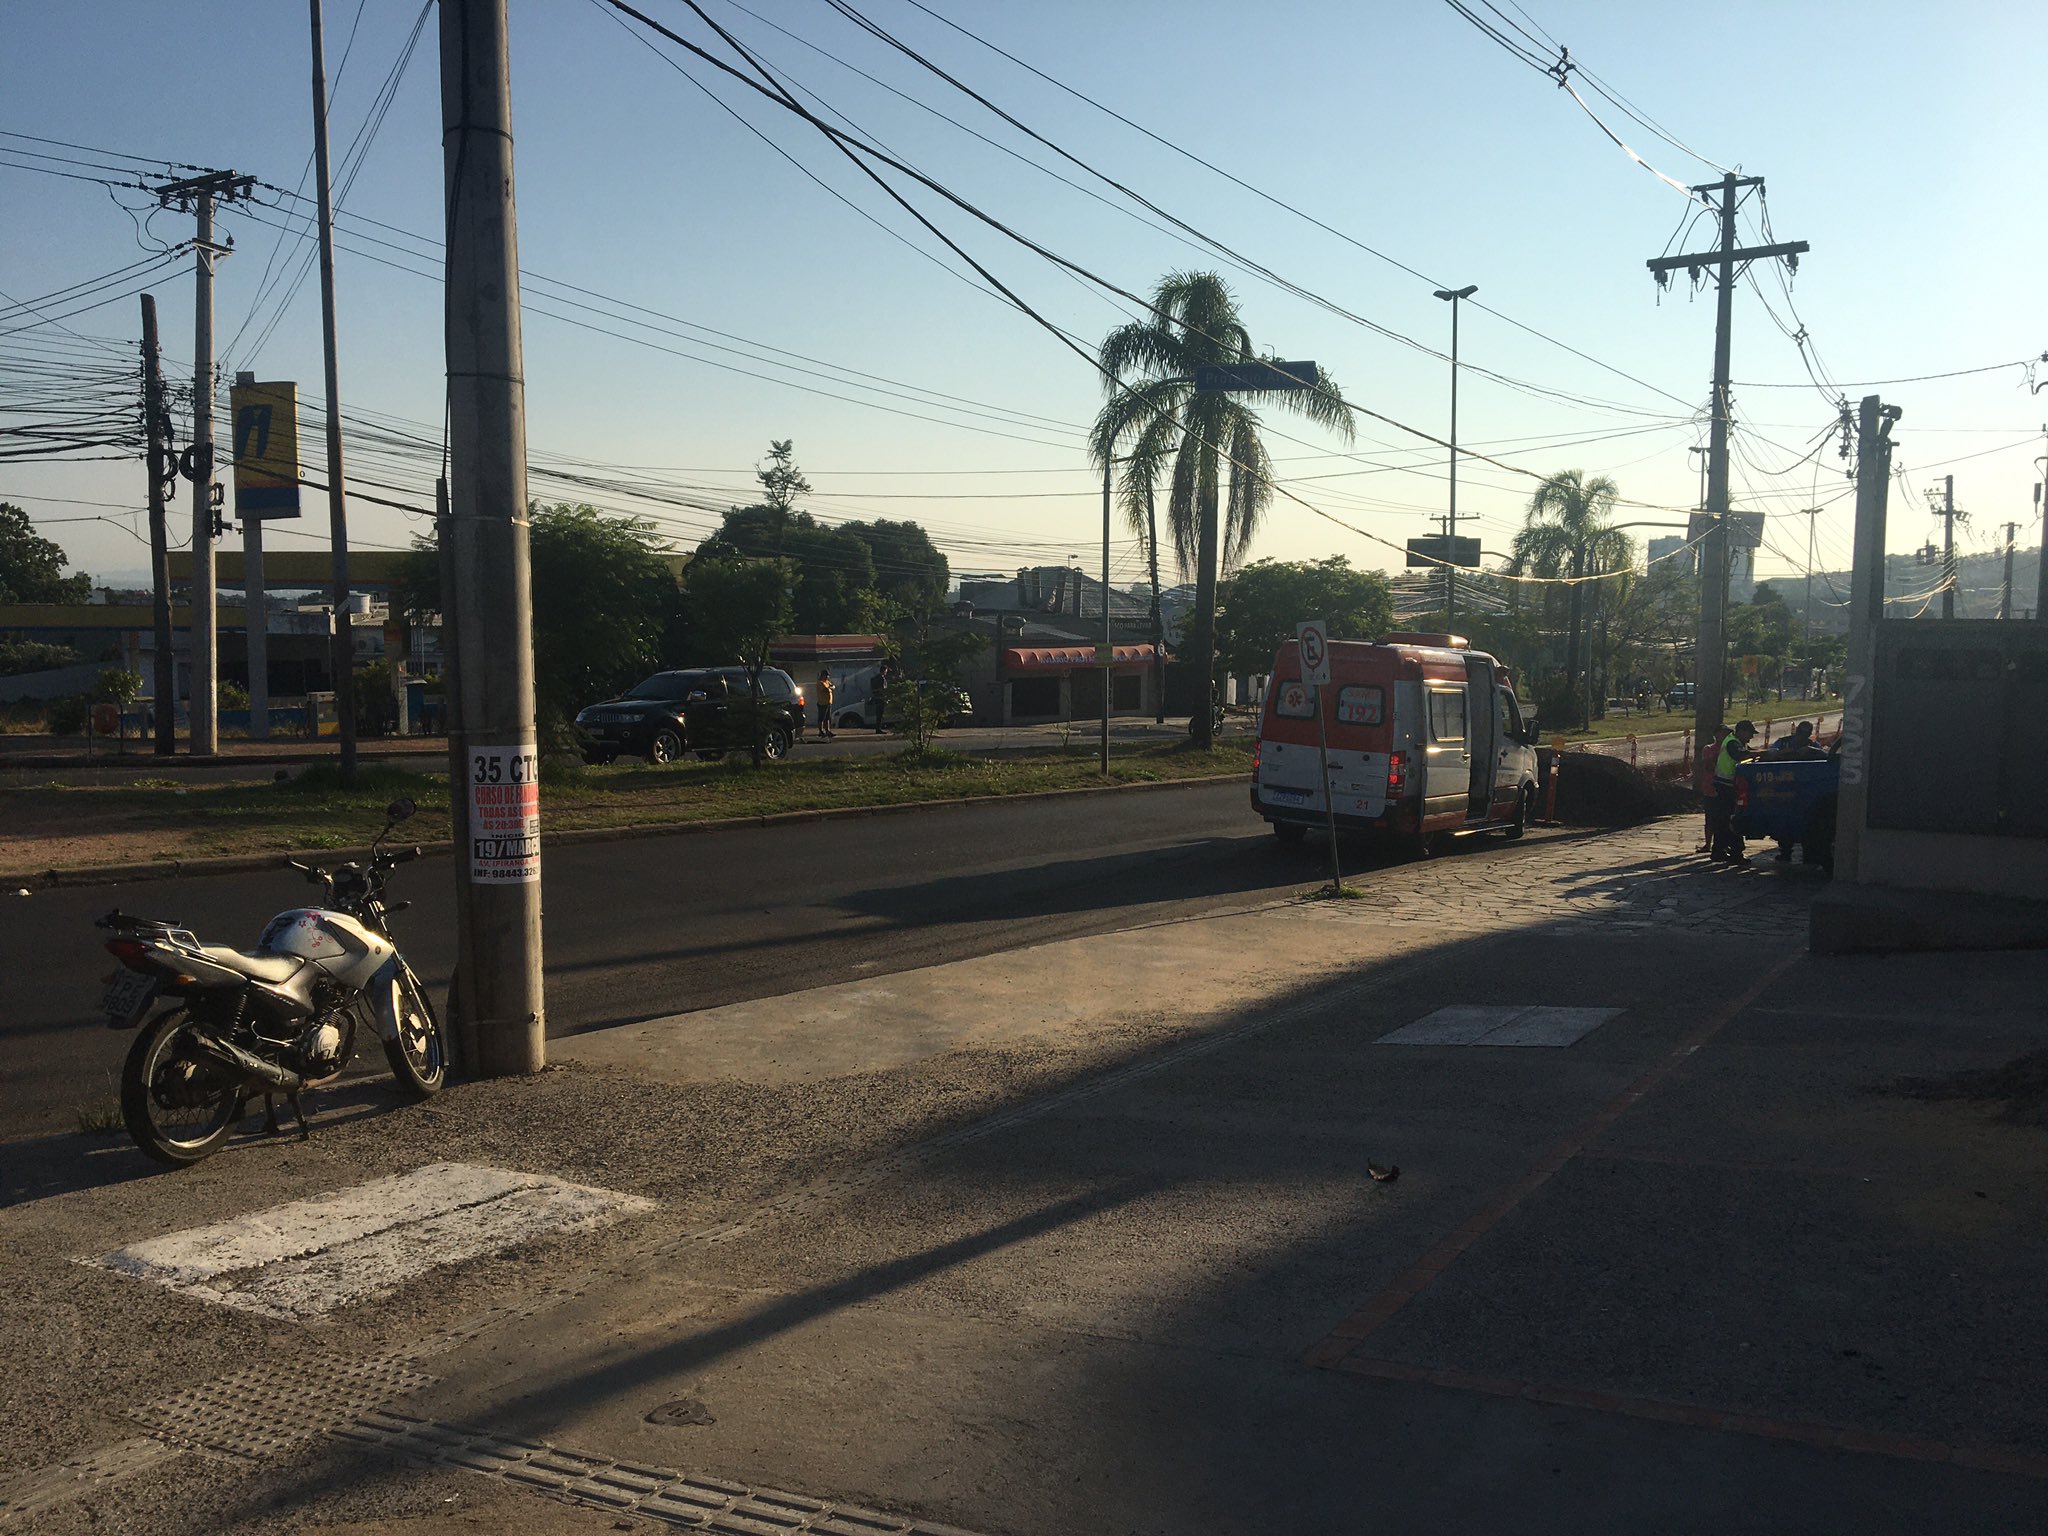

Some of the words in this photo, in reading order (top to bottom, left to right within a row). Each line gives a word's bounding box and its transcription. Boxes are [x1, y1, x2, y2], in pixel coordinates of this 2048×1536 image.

[1347, 703, 1377, 721] 192
[474, 755, 502, 782] 35
[475, 785, 503, 804] CURSO
[479, 806, 506, 818] TODAS
[1355, 799, 1369, 810] 21
